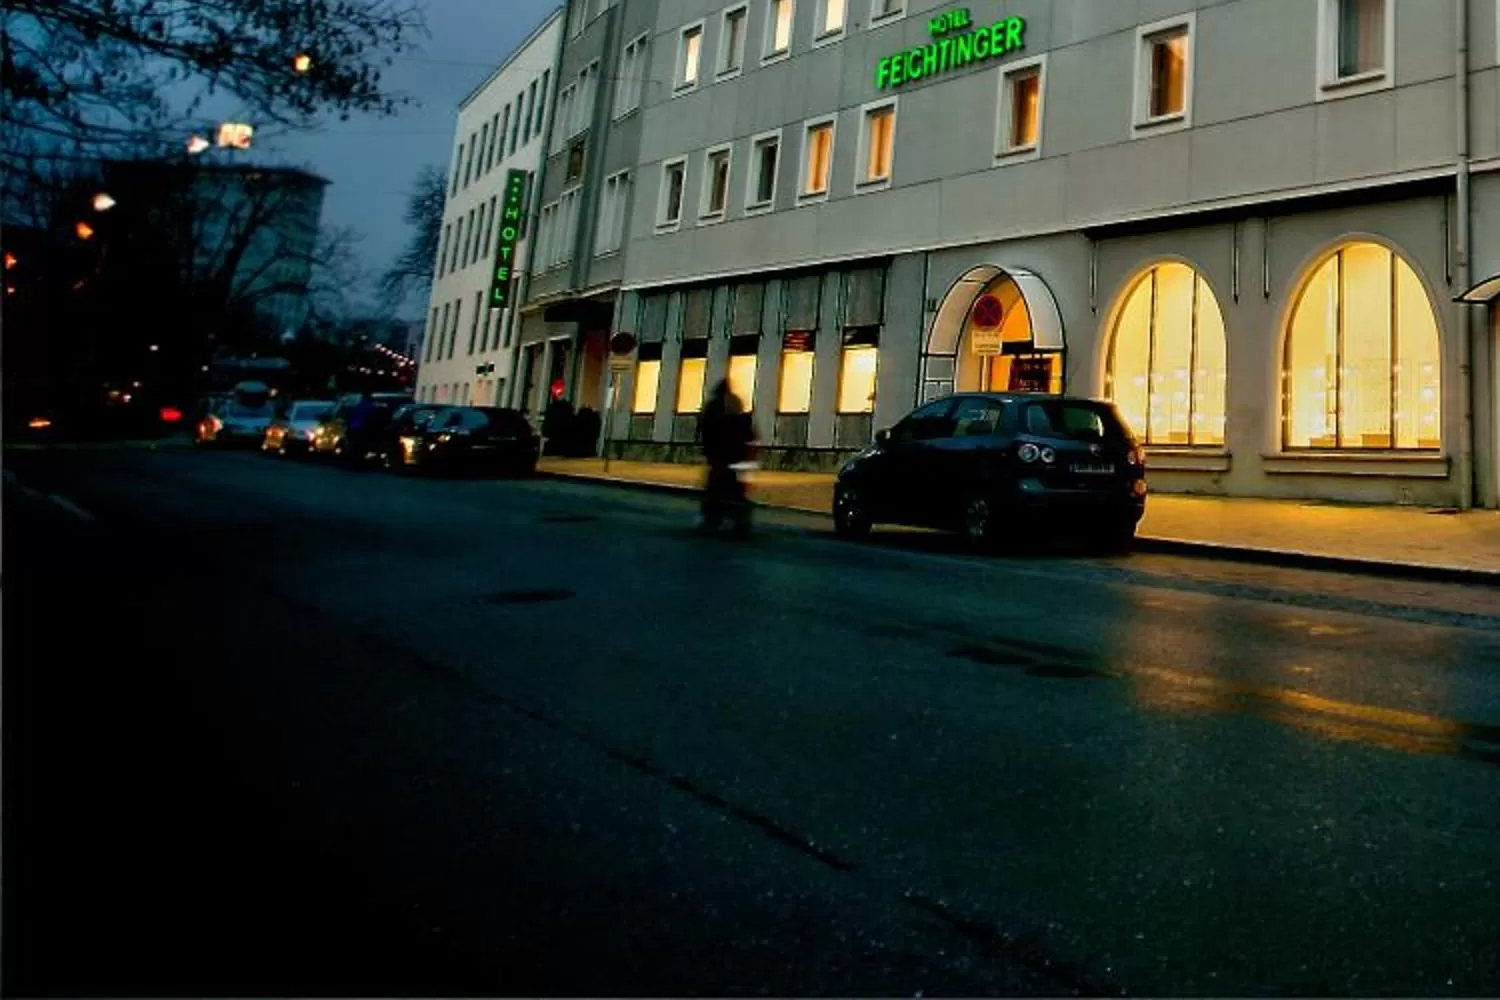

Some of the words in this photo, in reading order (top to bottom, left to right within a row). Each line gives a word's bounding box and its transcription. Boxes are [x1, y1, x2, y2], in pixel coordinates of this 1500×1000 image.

[876, 15, 1025, 89] FEICHTINGER
[928, 7, 971, 35] HOTEL
[494, 208, 519, 300] HOTEL
